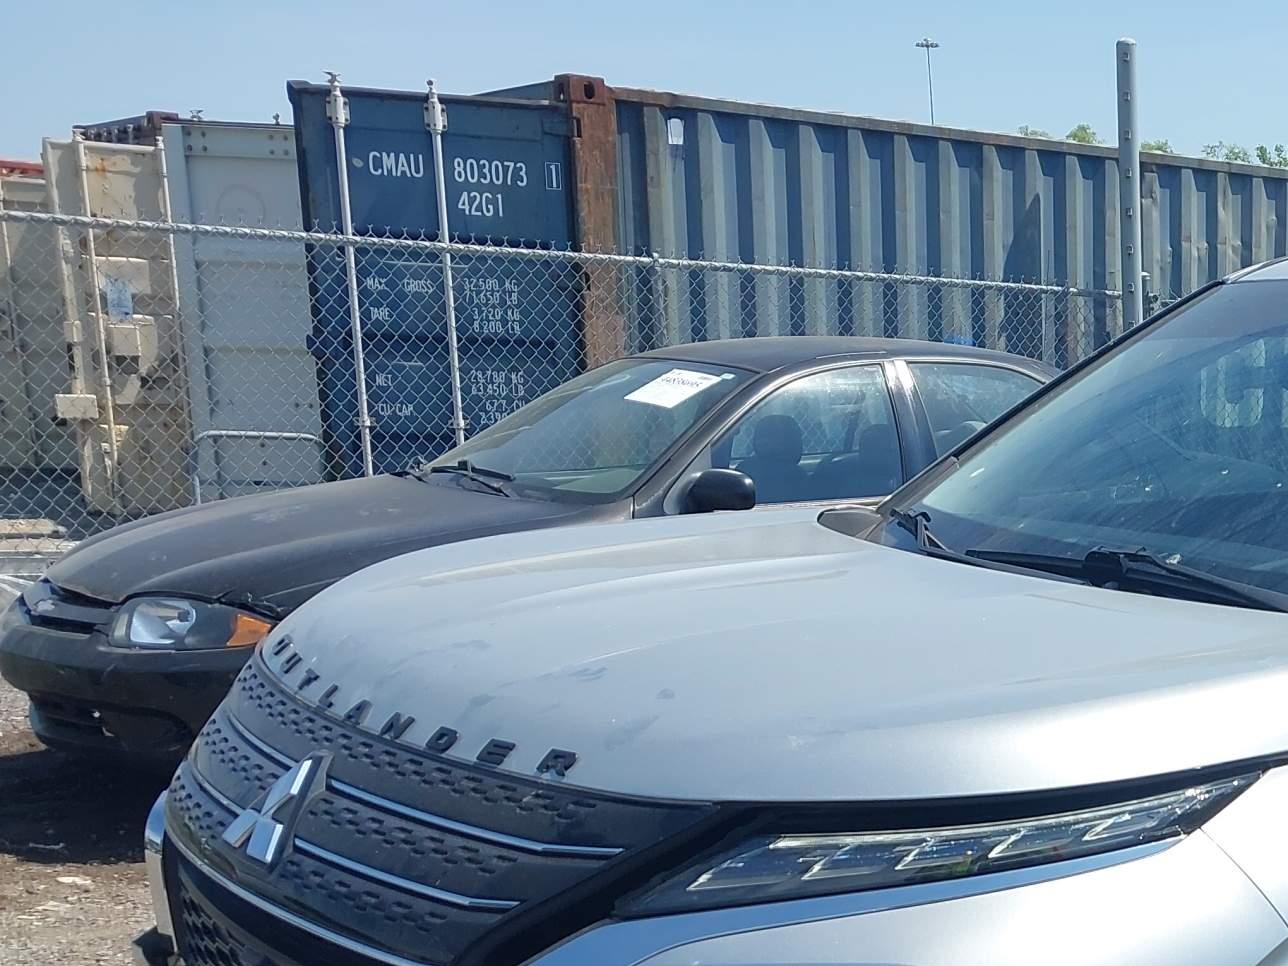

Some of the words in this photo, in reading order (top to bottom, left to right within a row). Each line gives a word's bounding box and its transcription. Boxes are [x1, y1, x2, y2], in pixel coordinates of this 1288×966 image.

[368, 151, 424, 177] CMAU
[453, 157, 528, 187] 803073
[548, 163, 559, 189] 1
[457, 191, 504, 217] 42G1
[366, 277, 386, 290] MAX
[404, 279, 433, 293] GROSS
[505, 279, 518, 291] KG
[369, 306, 390, 320] TARE
[507, 308, 520, 320] KG
[375, 374, 393, 387] NET
[511, 371, 524, 383] KG
[271, 633, 578, 779] OUTLANDER
